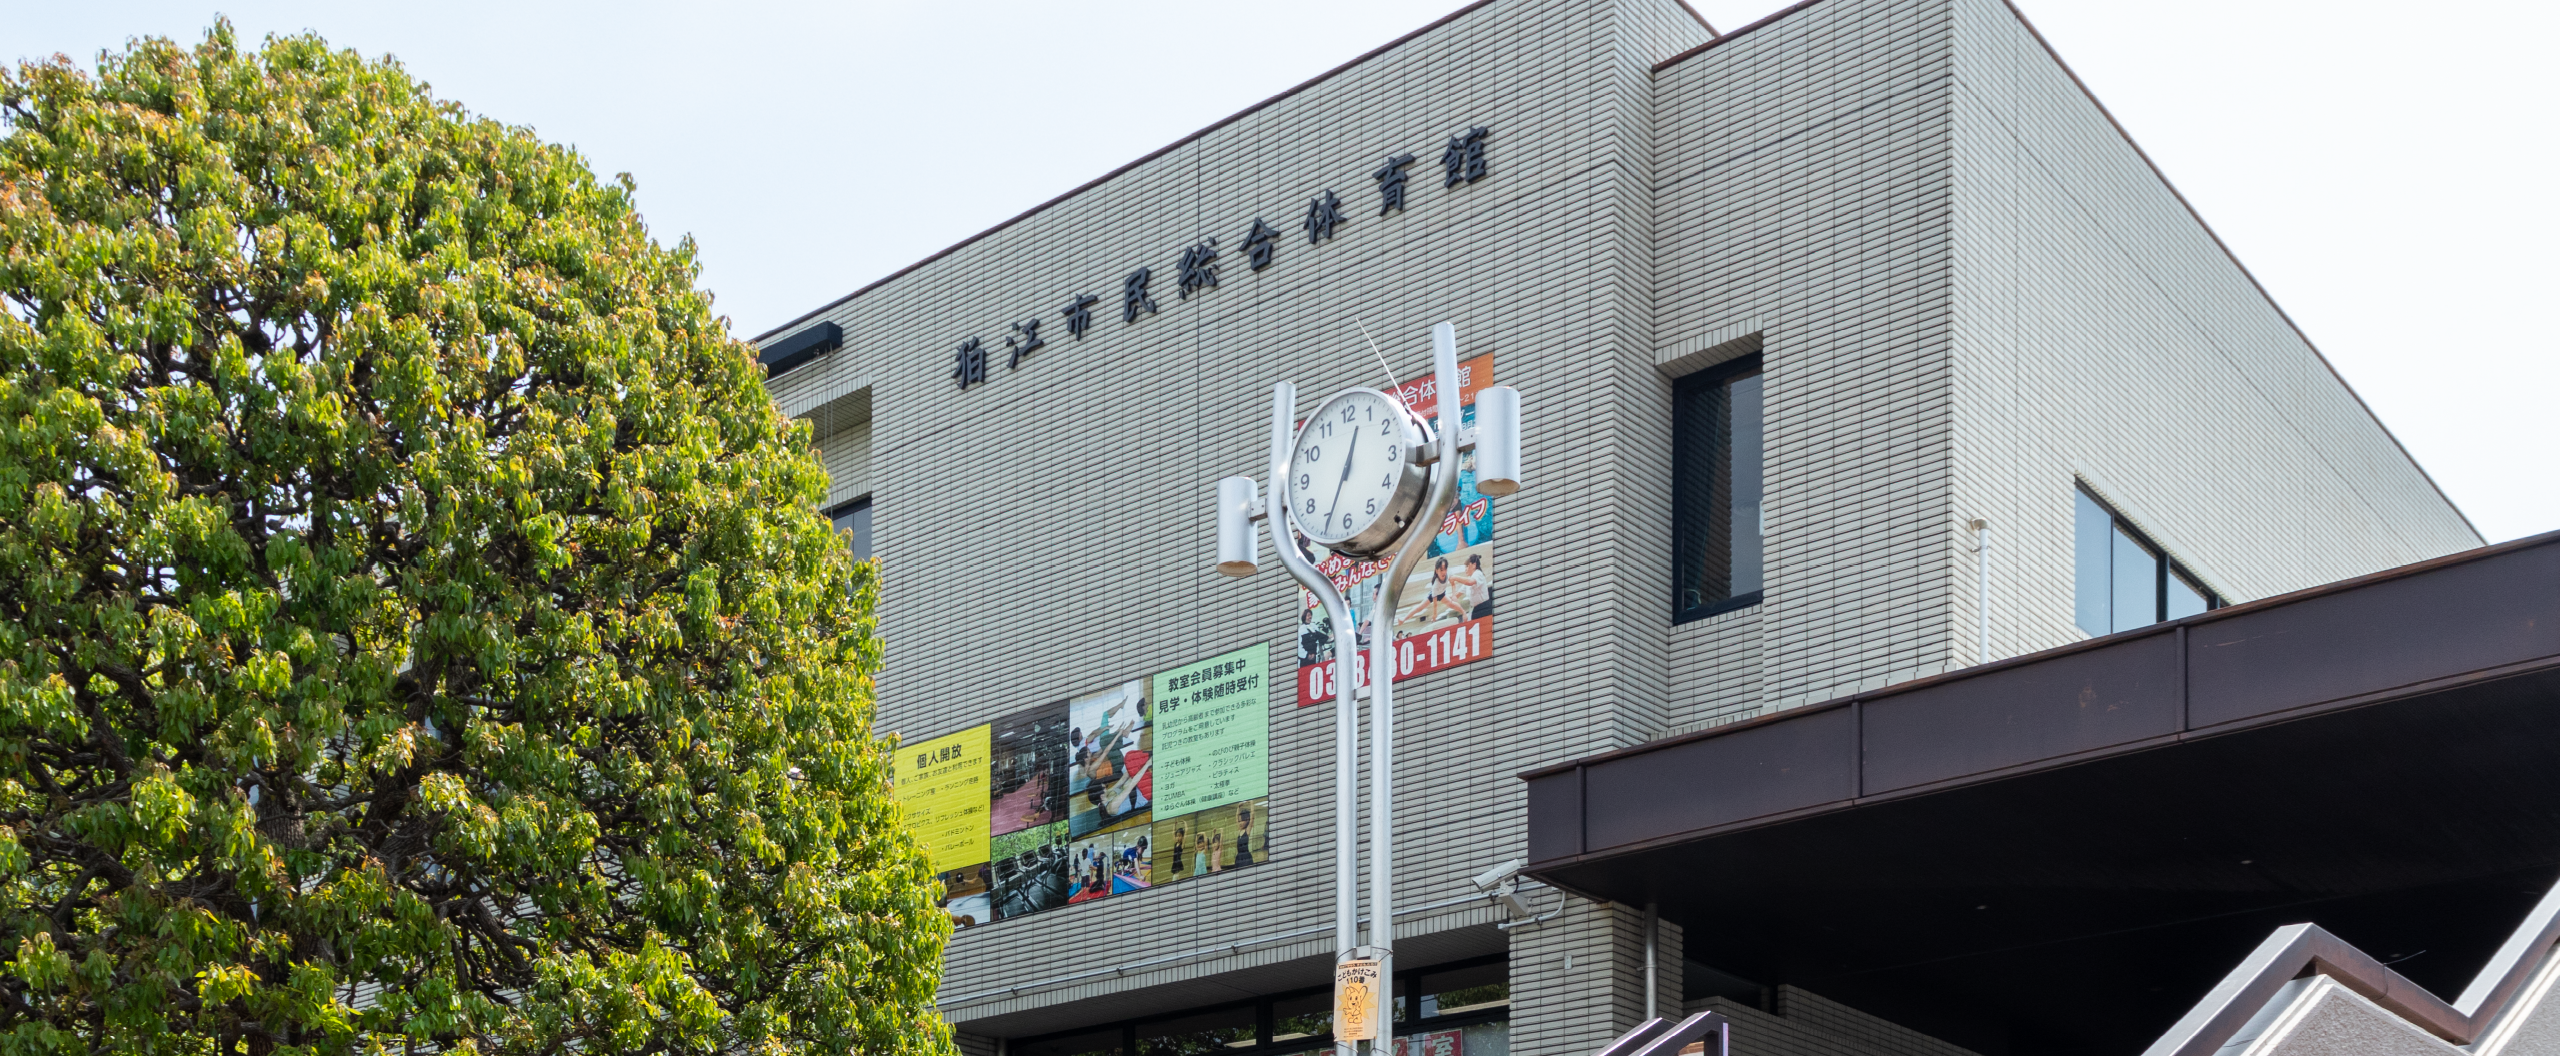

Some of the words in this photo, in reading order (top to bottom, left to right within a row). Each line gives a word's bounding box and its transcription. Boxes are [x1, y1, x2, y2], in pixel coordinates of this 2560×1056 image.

[952, 126, 1488, 390] 狛江市民総合体育館
[1340, 405, 1356, 424] 12
[1365, 405, 1372, 422] 1
[1319, 421, 1332, 439] 11
[1381, 418, 1391, 436] 2
[1304, 445, 1320, 464] 10
[1387, 444, 1397, 462] 3
[1300, 474, 1310, 490] 9
[1381, 473, 1391, 490] 4
[1306, 498, 1316, 514] 8
[1365, 498, 1376, 515] 5
[1342, 513, 1353, 529] 6
[1168, 658, 1246, 692] 教室会員募集中
[1159, 673, 1259, 714] 見学・体験随時受付
[1162, 714, 1235, 740] プログラムをご用意しています
[917, 743, 962, 769] 個人開放
[1338, 968, 1377, 981] こどもかけこみ
